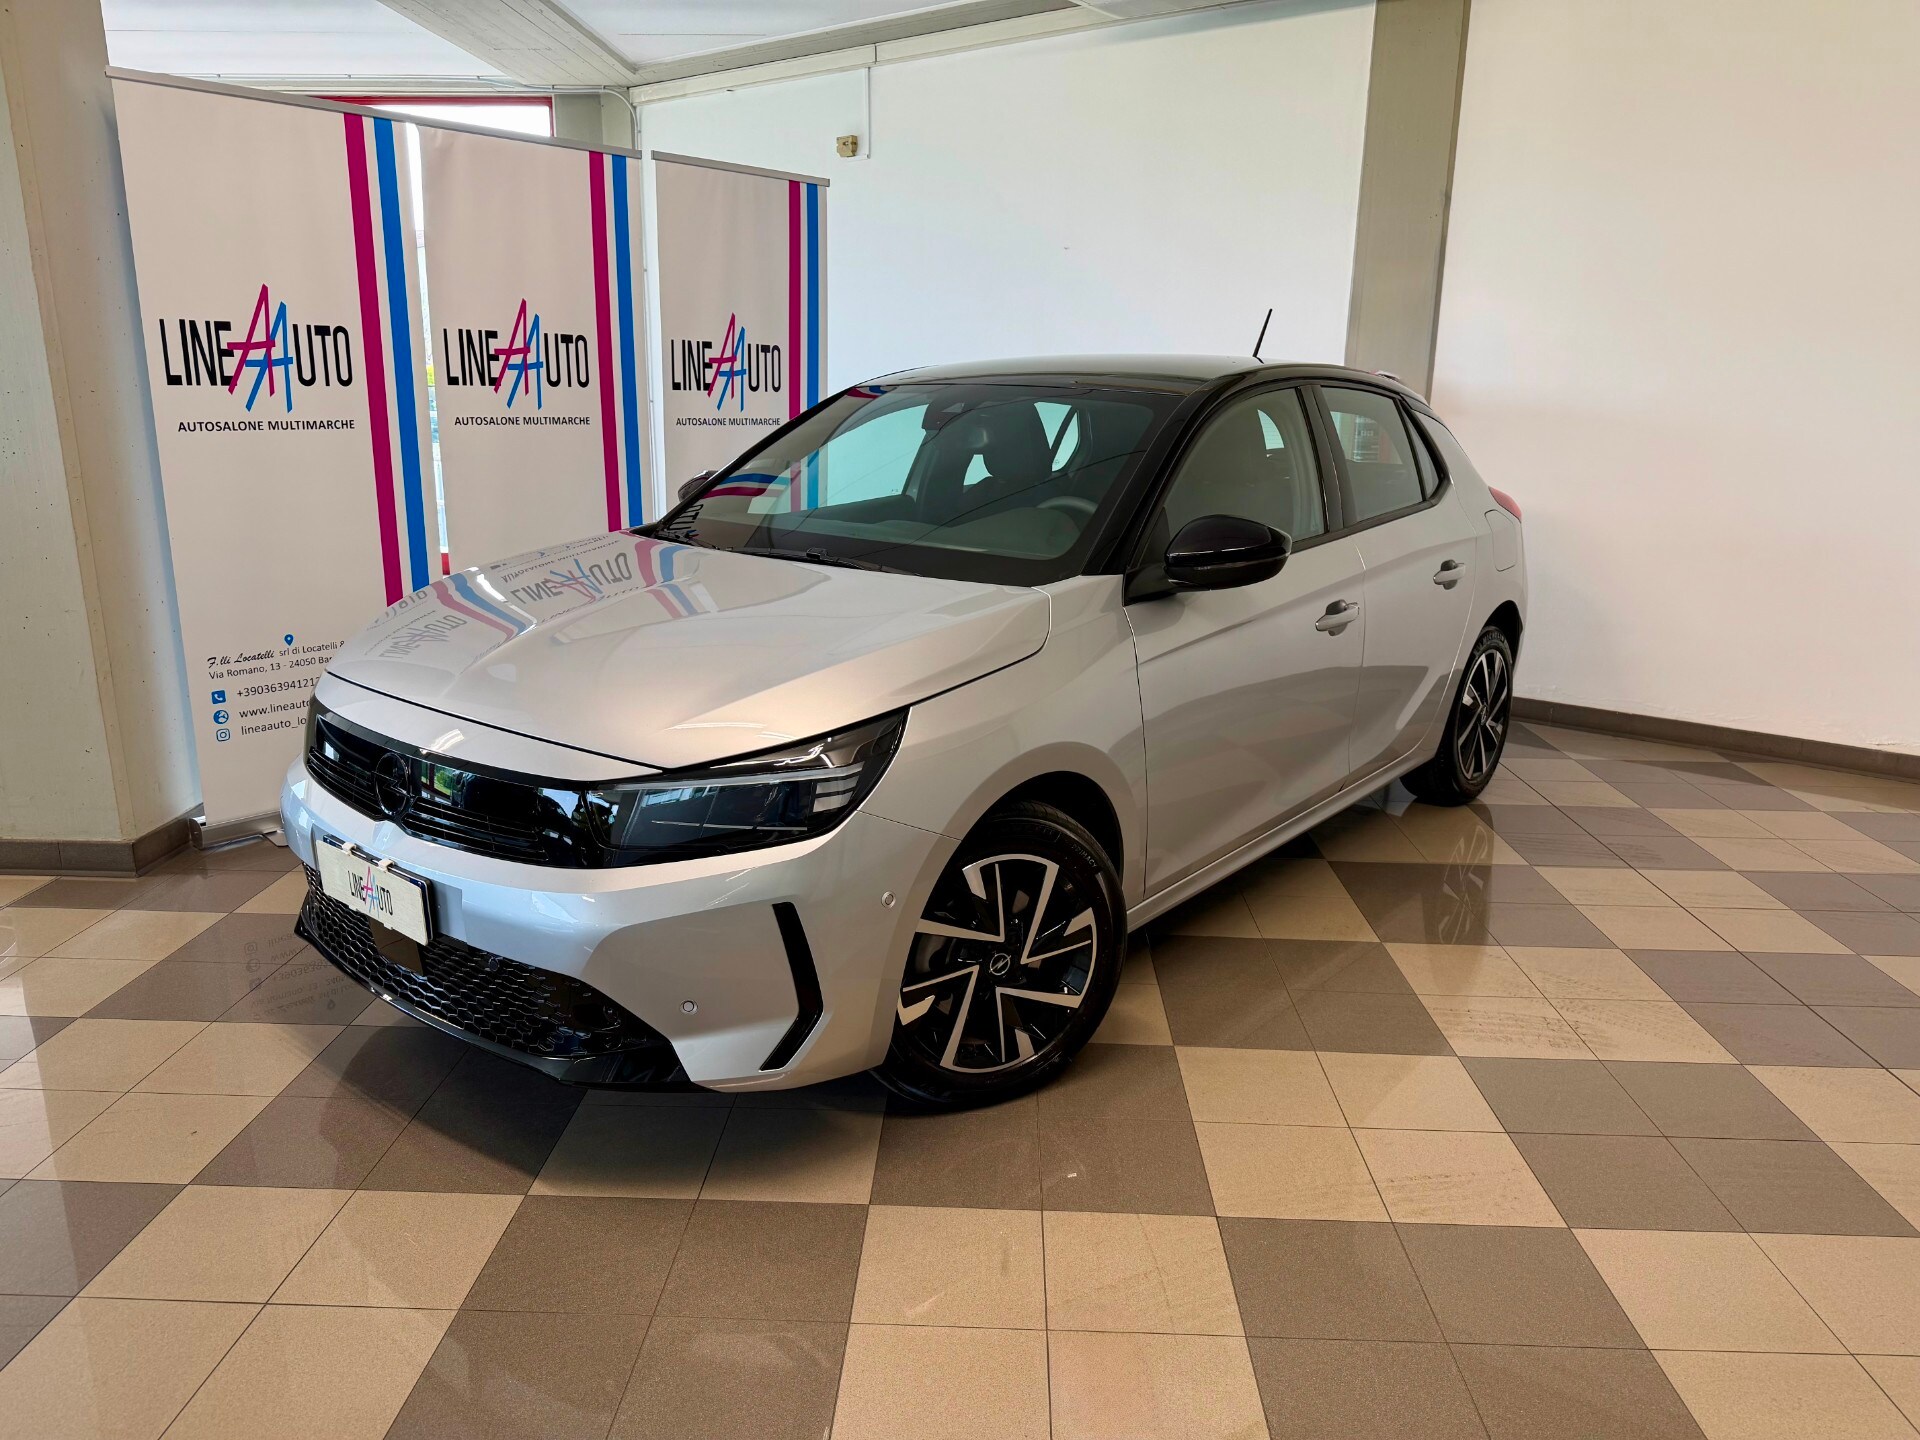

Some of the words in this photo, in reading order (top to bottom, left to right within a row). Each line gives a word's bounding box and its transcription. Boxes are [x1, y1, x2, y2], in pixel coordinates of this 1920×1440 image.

[178, 421, 264, 432] AUTOSALONE
[268, 419, 355, 431] MULTIMARCHE
[454, 416, 520, 426] AUTOSALONE
[523, 416, 590, 426] MULTIMARCHE
[676, 417, 727, 426] AUTOSALONE
[728, 417, 781, 426] MULTIMARCHE
[206, 656, 231, 669] F.lli
[234, 650, 275, 664] Locatelli
[279, 647, 290, 657] srl
[292, 646, 300, 655] di
[302, 641, 338, 654] Locatelli
[208, 670, 224, 679] Via
[227, 665, 268, 678] Romano,
[270, 662, 281, 671] 13
[289, 658, 316, 669] 24050
